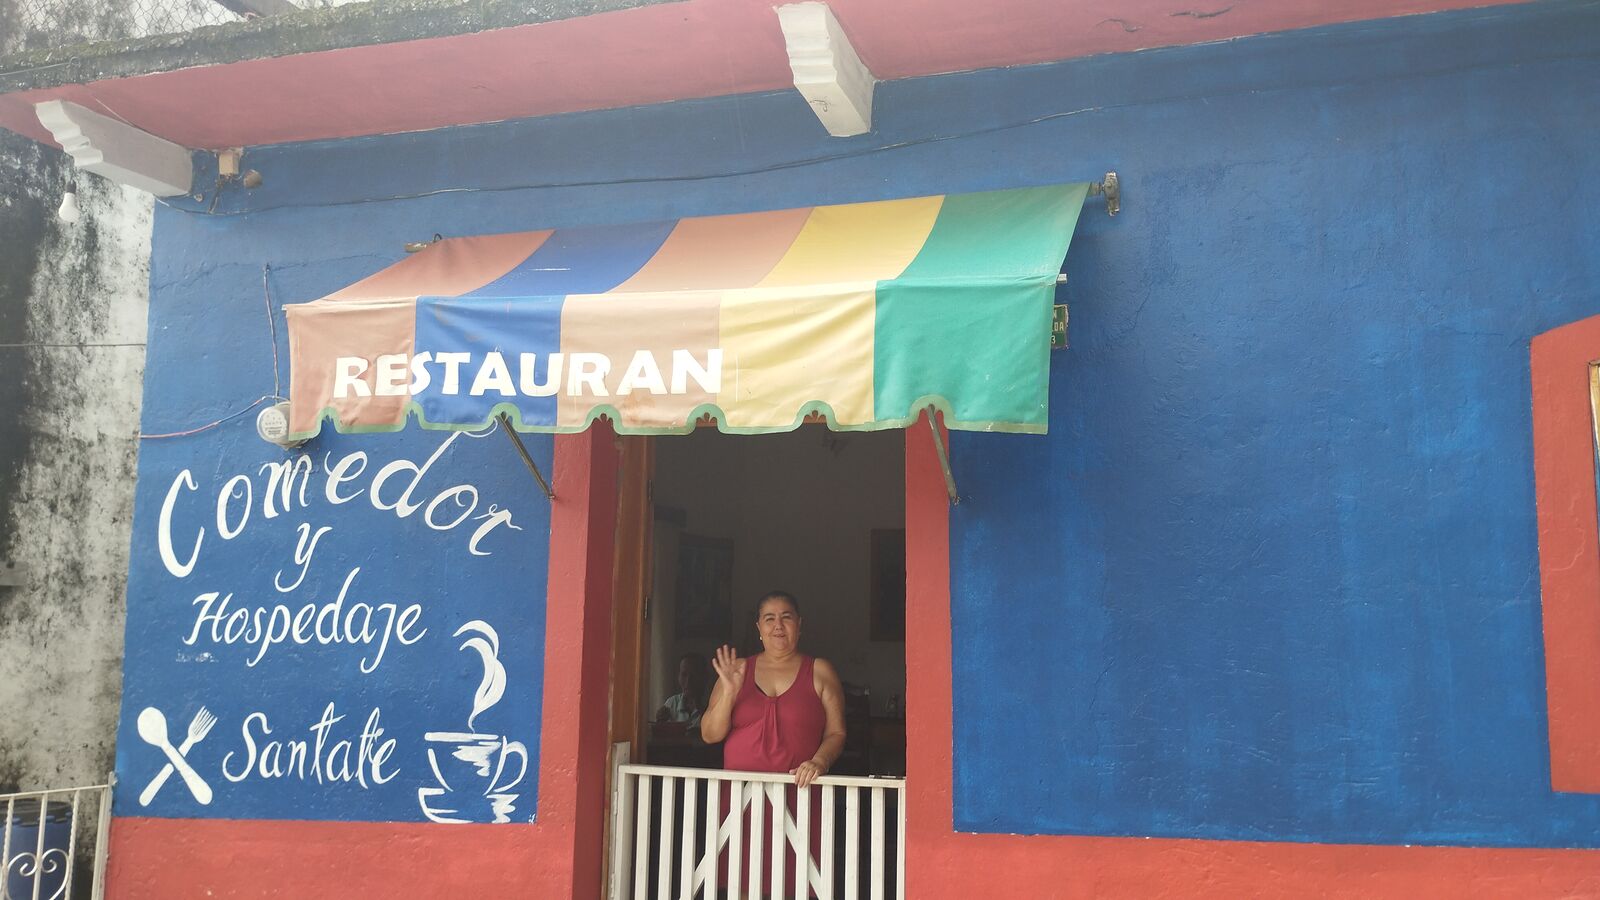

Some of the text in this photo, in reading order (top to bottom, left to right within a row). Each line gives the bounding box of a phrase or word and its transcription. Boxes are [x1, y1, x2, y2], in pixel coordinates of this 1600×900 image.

[333, 348, 724, 399] RESTAURAN
[157, 417, 523, 578] Comedor
[274, 522, 333, 593] y
[182, 566, 427, 674] Hospedaje
